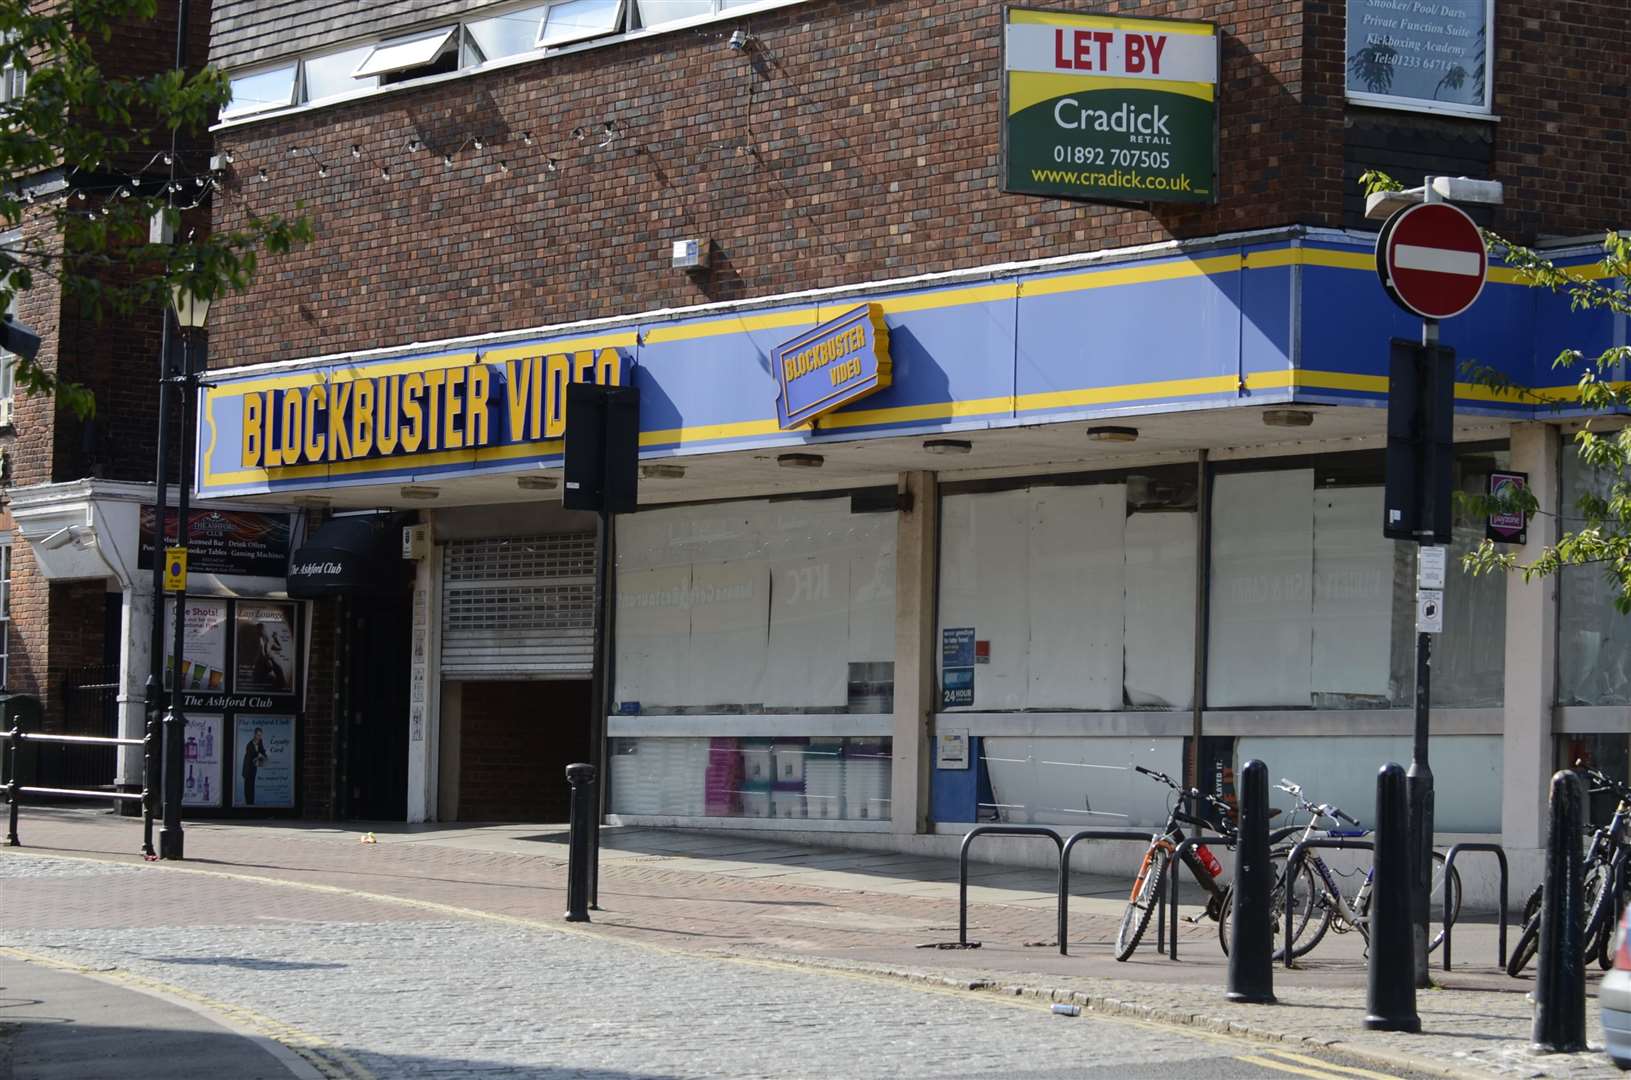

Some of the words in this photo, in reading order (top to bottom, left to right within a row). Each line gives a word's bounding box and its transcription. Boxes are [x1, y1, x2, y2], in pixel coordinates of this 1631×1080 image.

[1413, 2, 1438, 14] Pool/
[1440, 7, 1467, 18] Darts
[1362, 14, 1398, 28] Private
[1400, 19, 1444, 34] Function
[1446, 25, 1471, 37] Suite
[1055, 29, 1113, 71] LET
[1125, 34, 1167, 75] BY
[1366, 33, 1420, 50] Kickboxing
[1424, 40, 1466, 57] Academy
[1054, 98, 1170, 135] Cradick
[1130, 135, 1172, 145] RETAIL
[1054, 146, 1105, 165] 01892
[1110, 149, 1170, 168] 707505
[1031, 169, 1191, 192] www.cradick.co.uk
[786, 324, 866, 383] BLOCKBUSTER
[830, 357, 862, 387] VIDEO
[241, 362, 495, 468] BLOCKBUSTER
[300, 562, 325, 577] Ashford
[323, 561, 343, 574] Club
[192, 607, 218, 616] Shots!
[184, 695, 203, 706] The
[207, 696, 246, 709] Ashford
[248, 696, 273, 708] Club
[943, 690, 956, 702] 24
